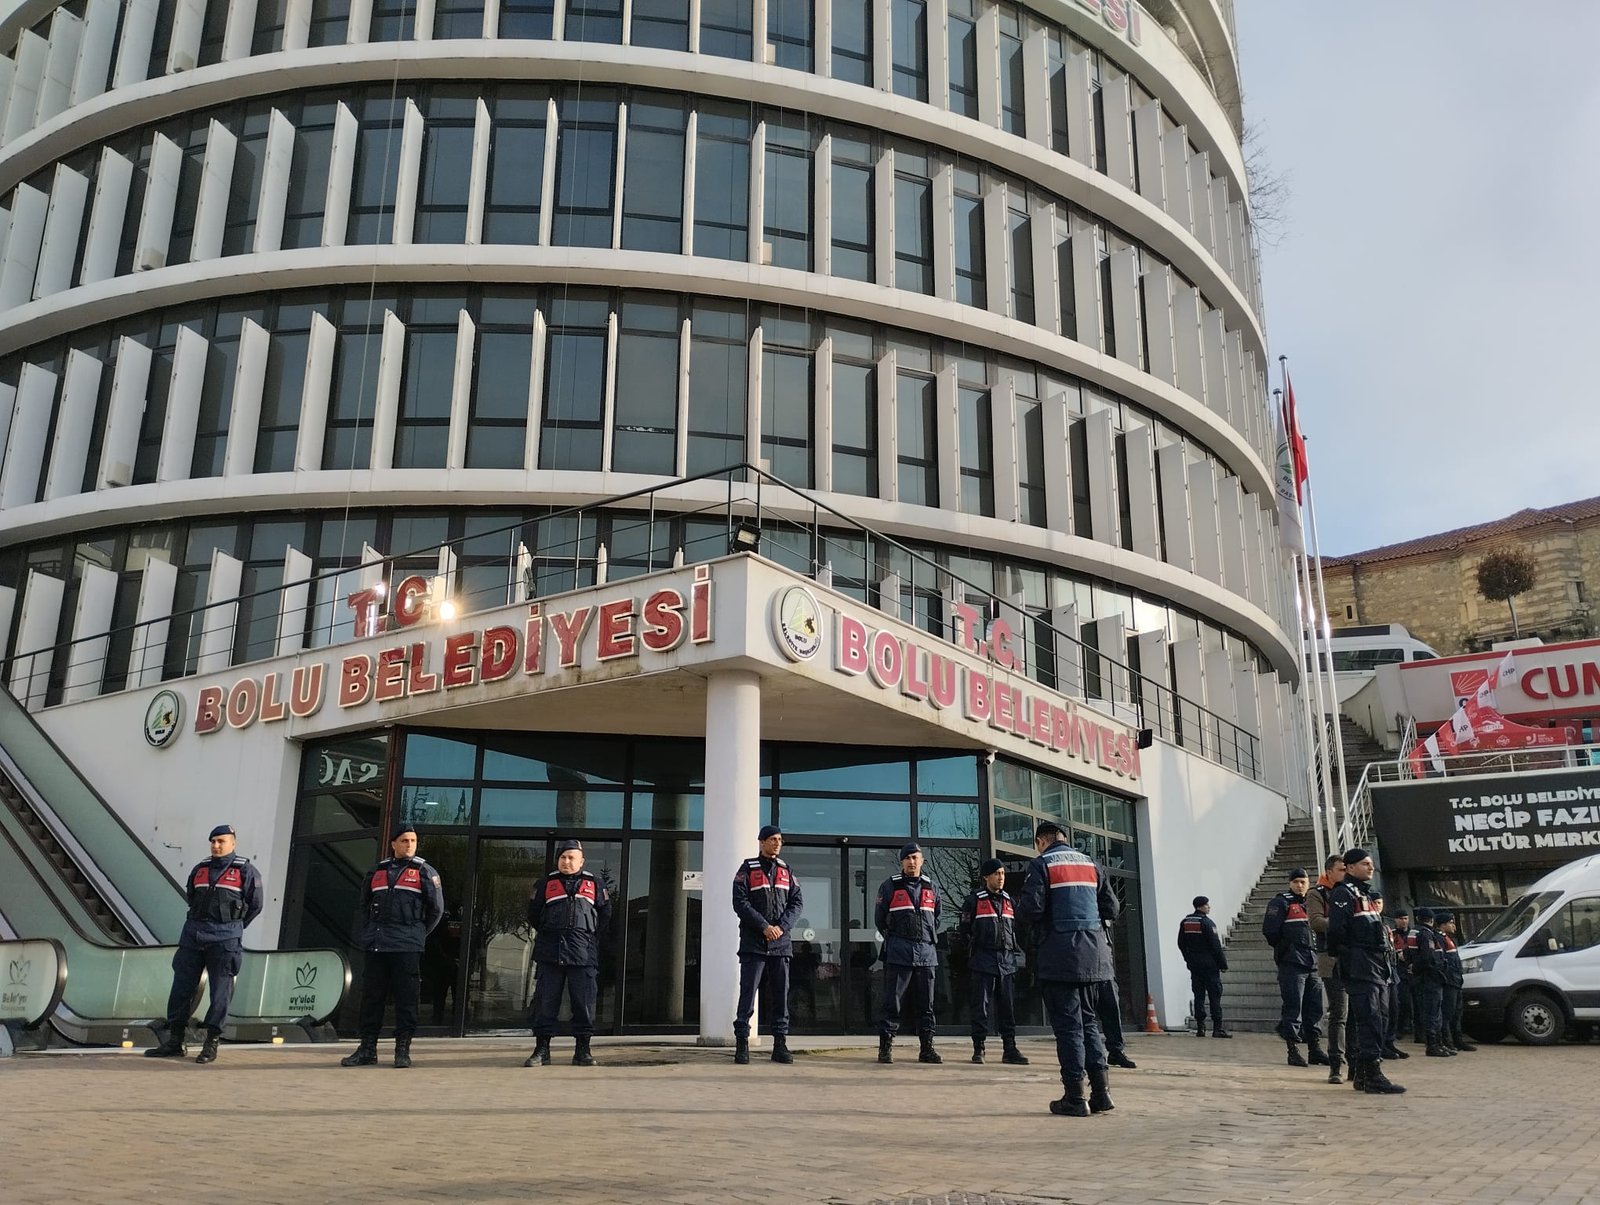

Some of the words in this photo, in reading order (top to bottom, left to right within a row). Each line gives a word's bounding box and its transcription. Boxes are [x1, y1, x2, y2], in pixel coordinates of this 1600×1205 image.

[194, 662, 329, 734] BOLU
[337, 564, 716, 708] BELEDİYESİ
[951, 600, 1023, 674] T.C.
[832, 612, 956, 710] BOLU
[963, 665, 1141, 780] BELEDİYESİ
[1449, 797, 1478, 809] T.C.
[1480, 793, 1523, 807] BOLU
[1454, 806, 1531, 831] NECİP
[1537, 805, 1600, 827] FAZI
[1448, 832, 1531, 852] KÜLTÜR
[1534, 830, 1600, 848] MERK
